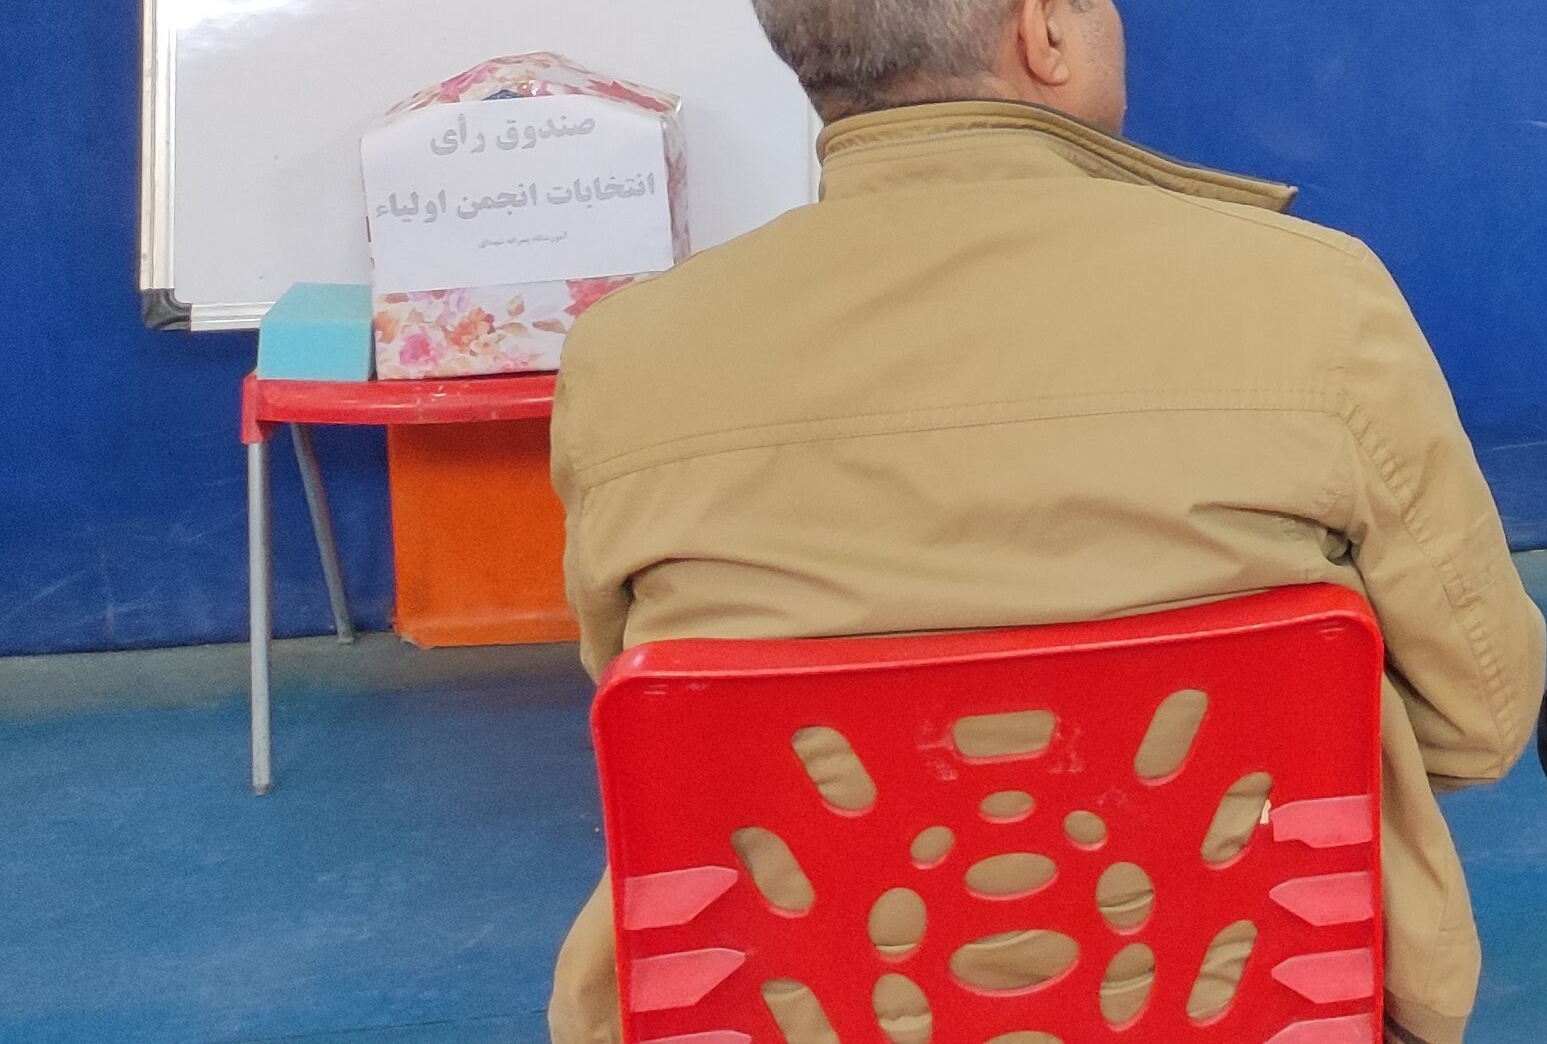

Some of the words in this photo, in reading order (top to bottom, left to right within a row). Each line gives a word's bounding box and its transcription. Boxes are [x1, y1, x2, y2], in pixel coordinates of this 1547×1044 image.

[495, 114, 597, 152] صندوق
[374, 188, 447, 224] اولیاء
[456, 182, 538, 220] انجمن
[546, 171, 656, 209] انتخابات
